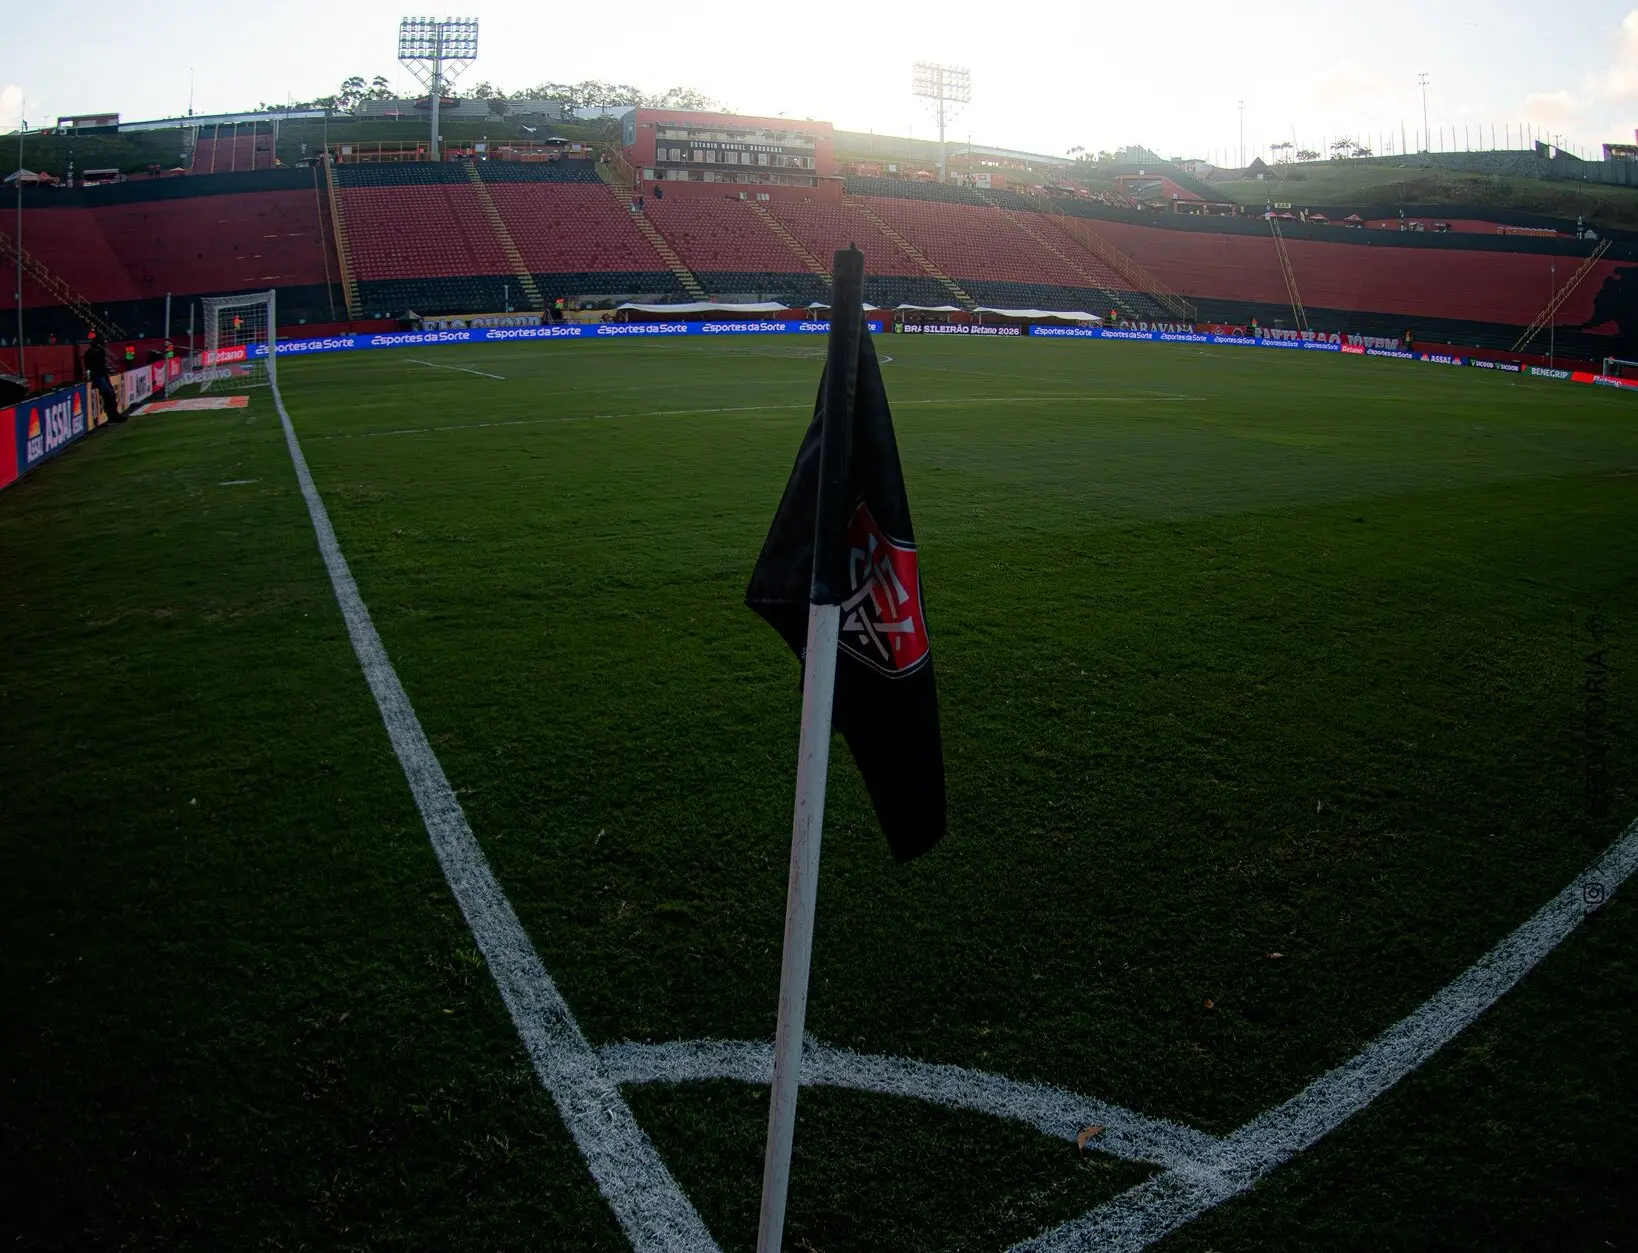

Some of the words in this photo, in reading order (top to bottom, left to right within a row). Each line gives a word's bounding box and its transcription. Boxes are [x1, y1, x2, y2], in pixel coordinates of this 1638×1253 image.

[597, 324, 645, 336] Esportes
[646, 325, 659, 334] da
[659, 324, 688, 333] Sorte
[702, 323, 747, 334] Esportes
[747, 323, 760, 332] da
[760, 322, 786, 331] Sorte
[799, 322, 831, 333] Esport
[971, 325, 998, 335] Betano
[998, 327, 1020, 335] 2026
[1034, 327, 1065, 336] Esportes
[1074, 328, 1092, 336] Sorte
[486, 328, 536, 340] Esportes
[537, 327, 551, 336] da
[552, 326, 581, 336] Sorte
[1101, 329, 1128, 339] Esportes
[1128, 331, 1137, 339] da
[1137, 331, 1153, 339] Sorte
[1160, 332, 1186, 341] Esportes
[1192, 334, 1207, 342] Sorte
[371, 333, 423, 346] Esportes
[424, 332, 438, 342] da
[439, 331, 470, 341] Sorte
[1214, 335, 1236, 344] Esportes
[1243, 337, 1256, 345] Sorte
[308, 340, 323, 350] da
[323, 339, 354, 350] Sorte
[1287, 340, 1299, 348] Sorte
[1342, 346, 1363, 355] Betano
[1397, 351, 1412, 359] Sorte
[1475, 361, 1494, 369] SICOOB
[1500, 364, 1519, 372] SICOOB
[1531, 367, 1569, 380] BENEGRIP
